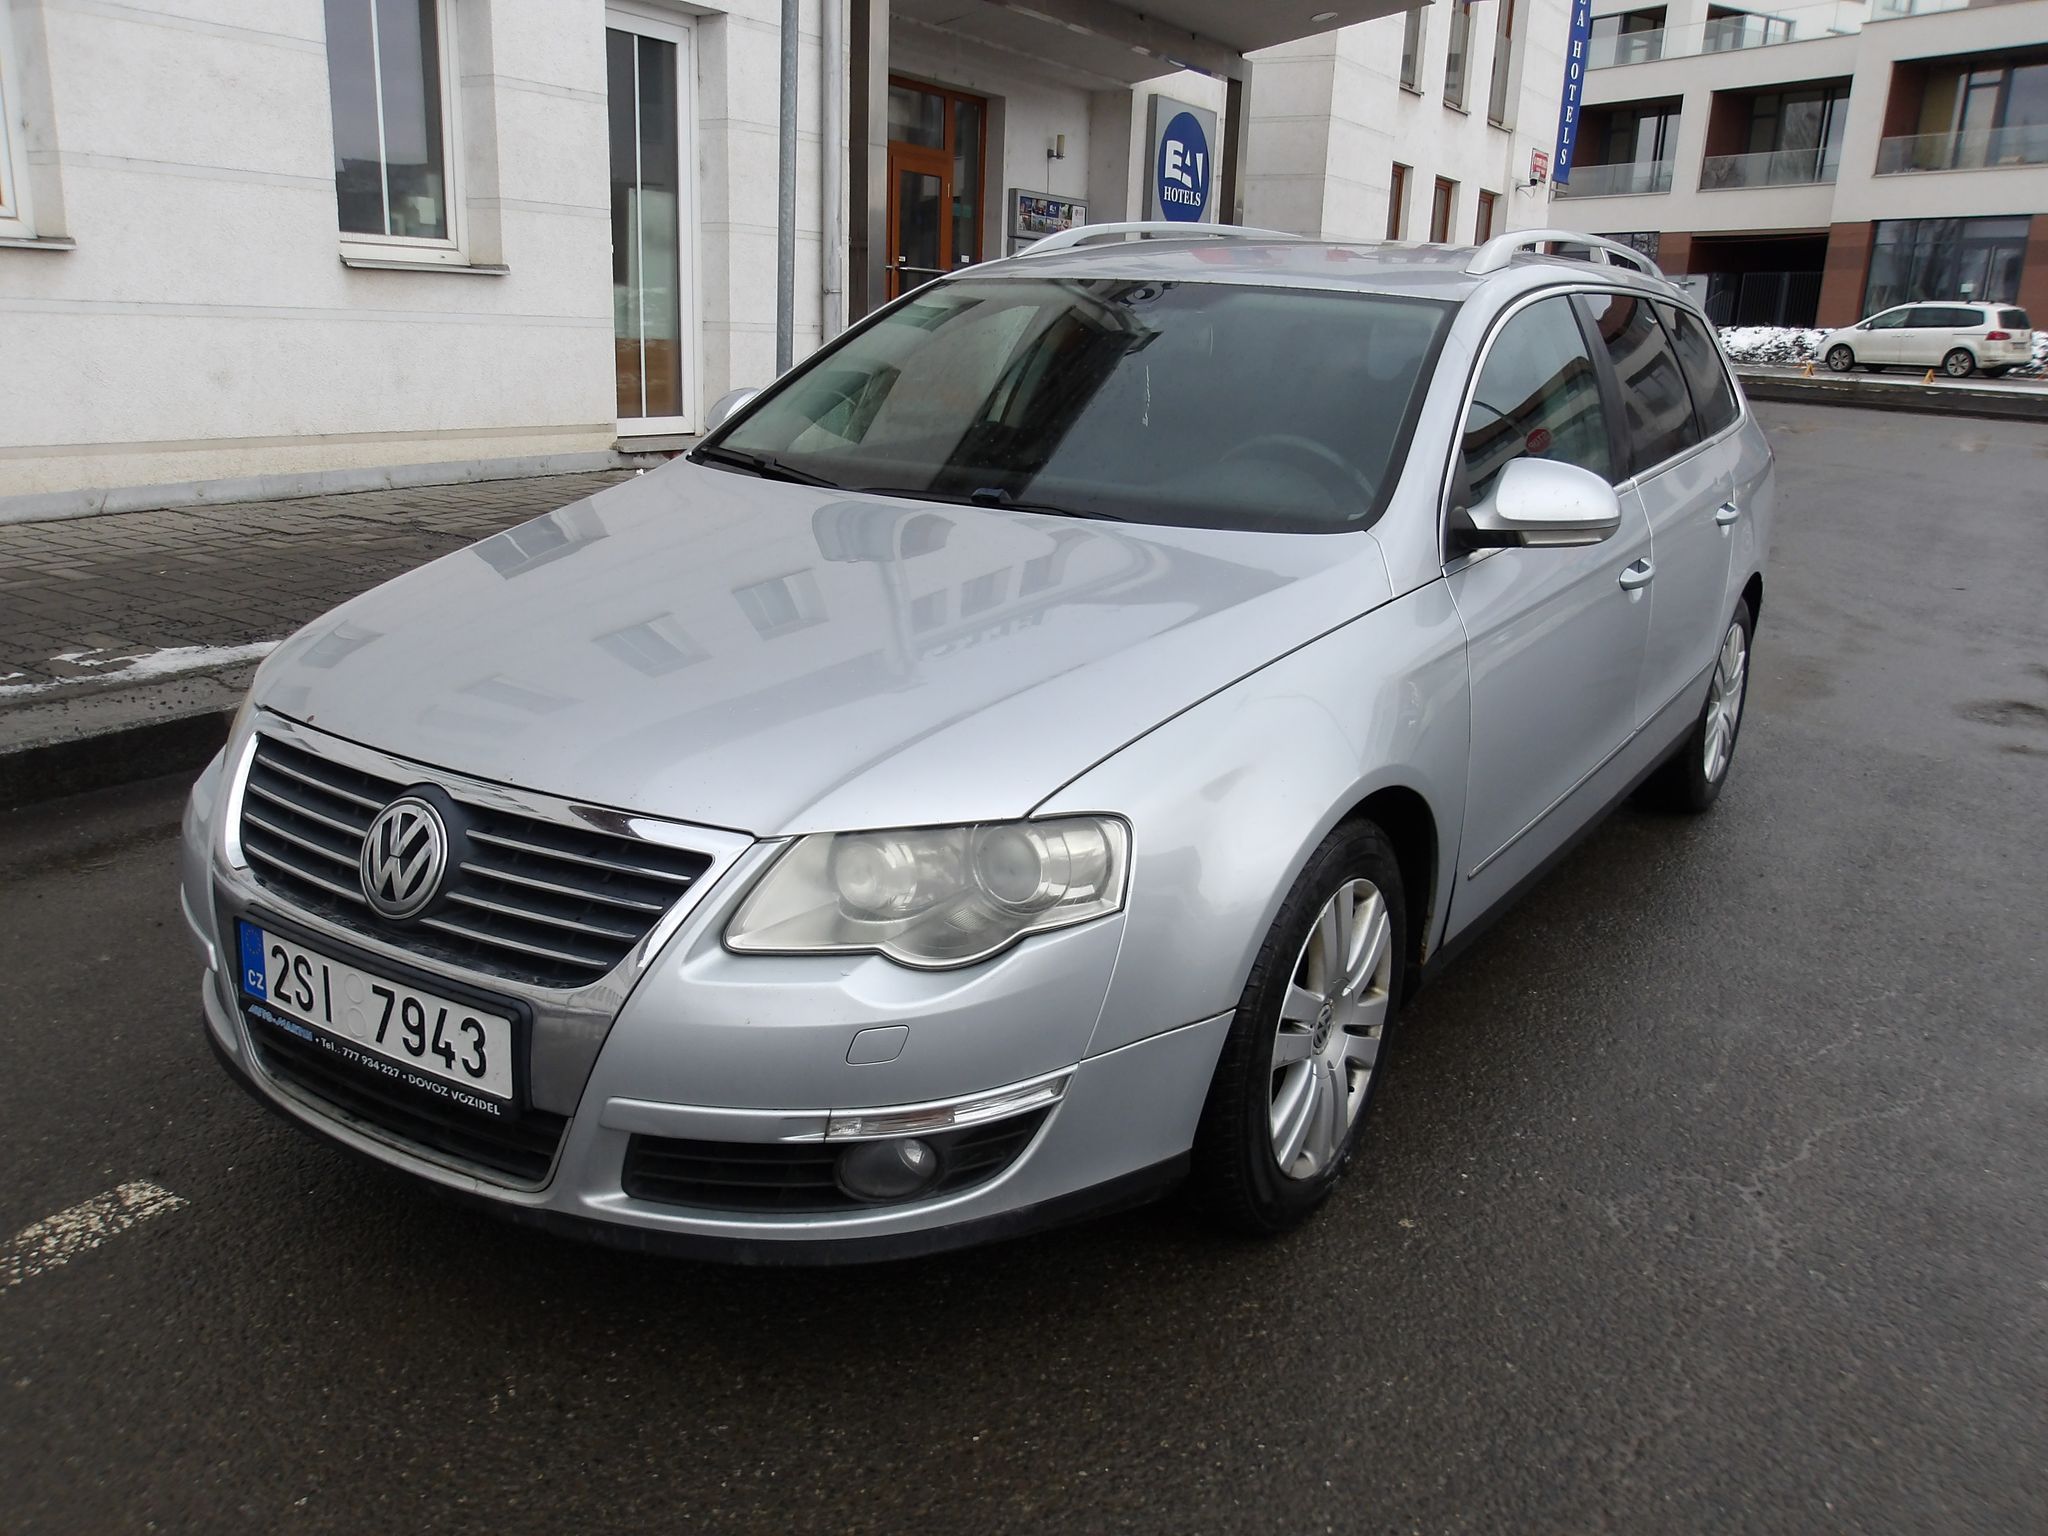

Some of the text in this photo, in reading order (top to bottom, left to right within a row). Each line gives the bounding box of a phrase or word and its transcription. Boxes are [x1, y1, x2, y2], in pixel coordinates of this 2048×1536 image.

[1560, 40, 1582, 165] HOTELS
[1164, 185, 1201, 207] HOTELS
[248, 969, 264, 990] CZ
[271, 944, 333, 1023] 2SI
[371, 983, 487, 1078] 7943
[342, 1047, 360, 1061] 777
[361, 1055, 379, 1070] 934
[380, 1063, 399, 1077] 227
[408, 1074, 449, 1096] DOVOZ
[451, 1090, 500, 1115] VOZIDEL
